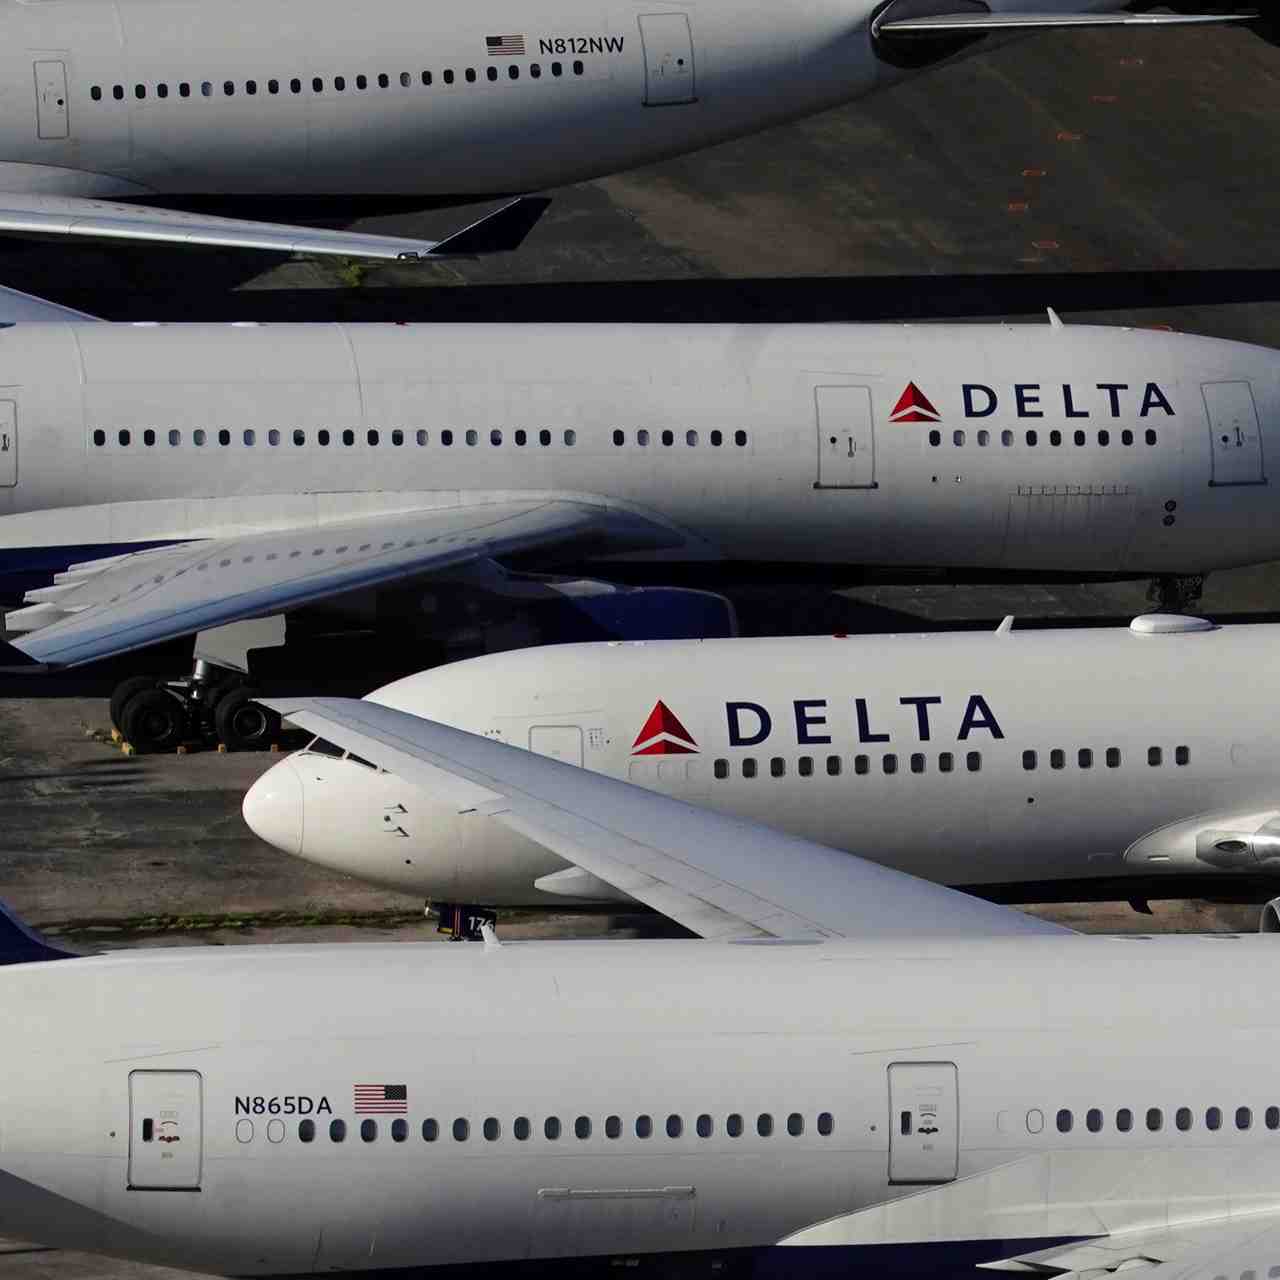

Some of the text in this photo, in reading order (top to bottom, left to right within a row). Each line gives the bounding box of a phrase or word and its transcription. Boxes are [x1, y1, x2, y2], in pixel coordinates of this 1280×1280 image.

[539, 36, 625, 55] N812NW
[961, 382, 1176, 418] DELTA
[726, 694, 1005, 748] DELTA
[234, 1096, 333, 1117] N865DA
